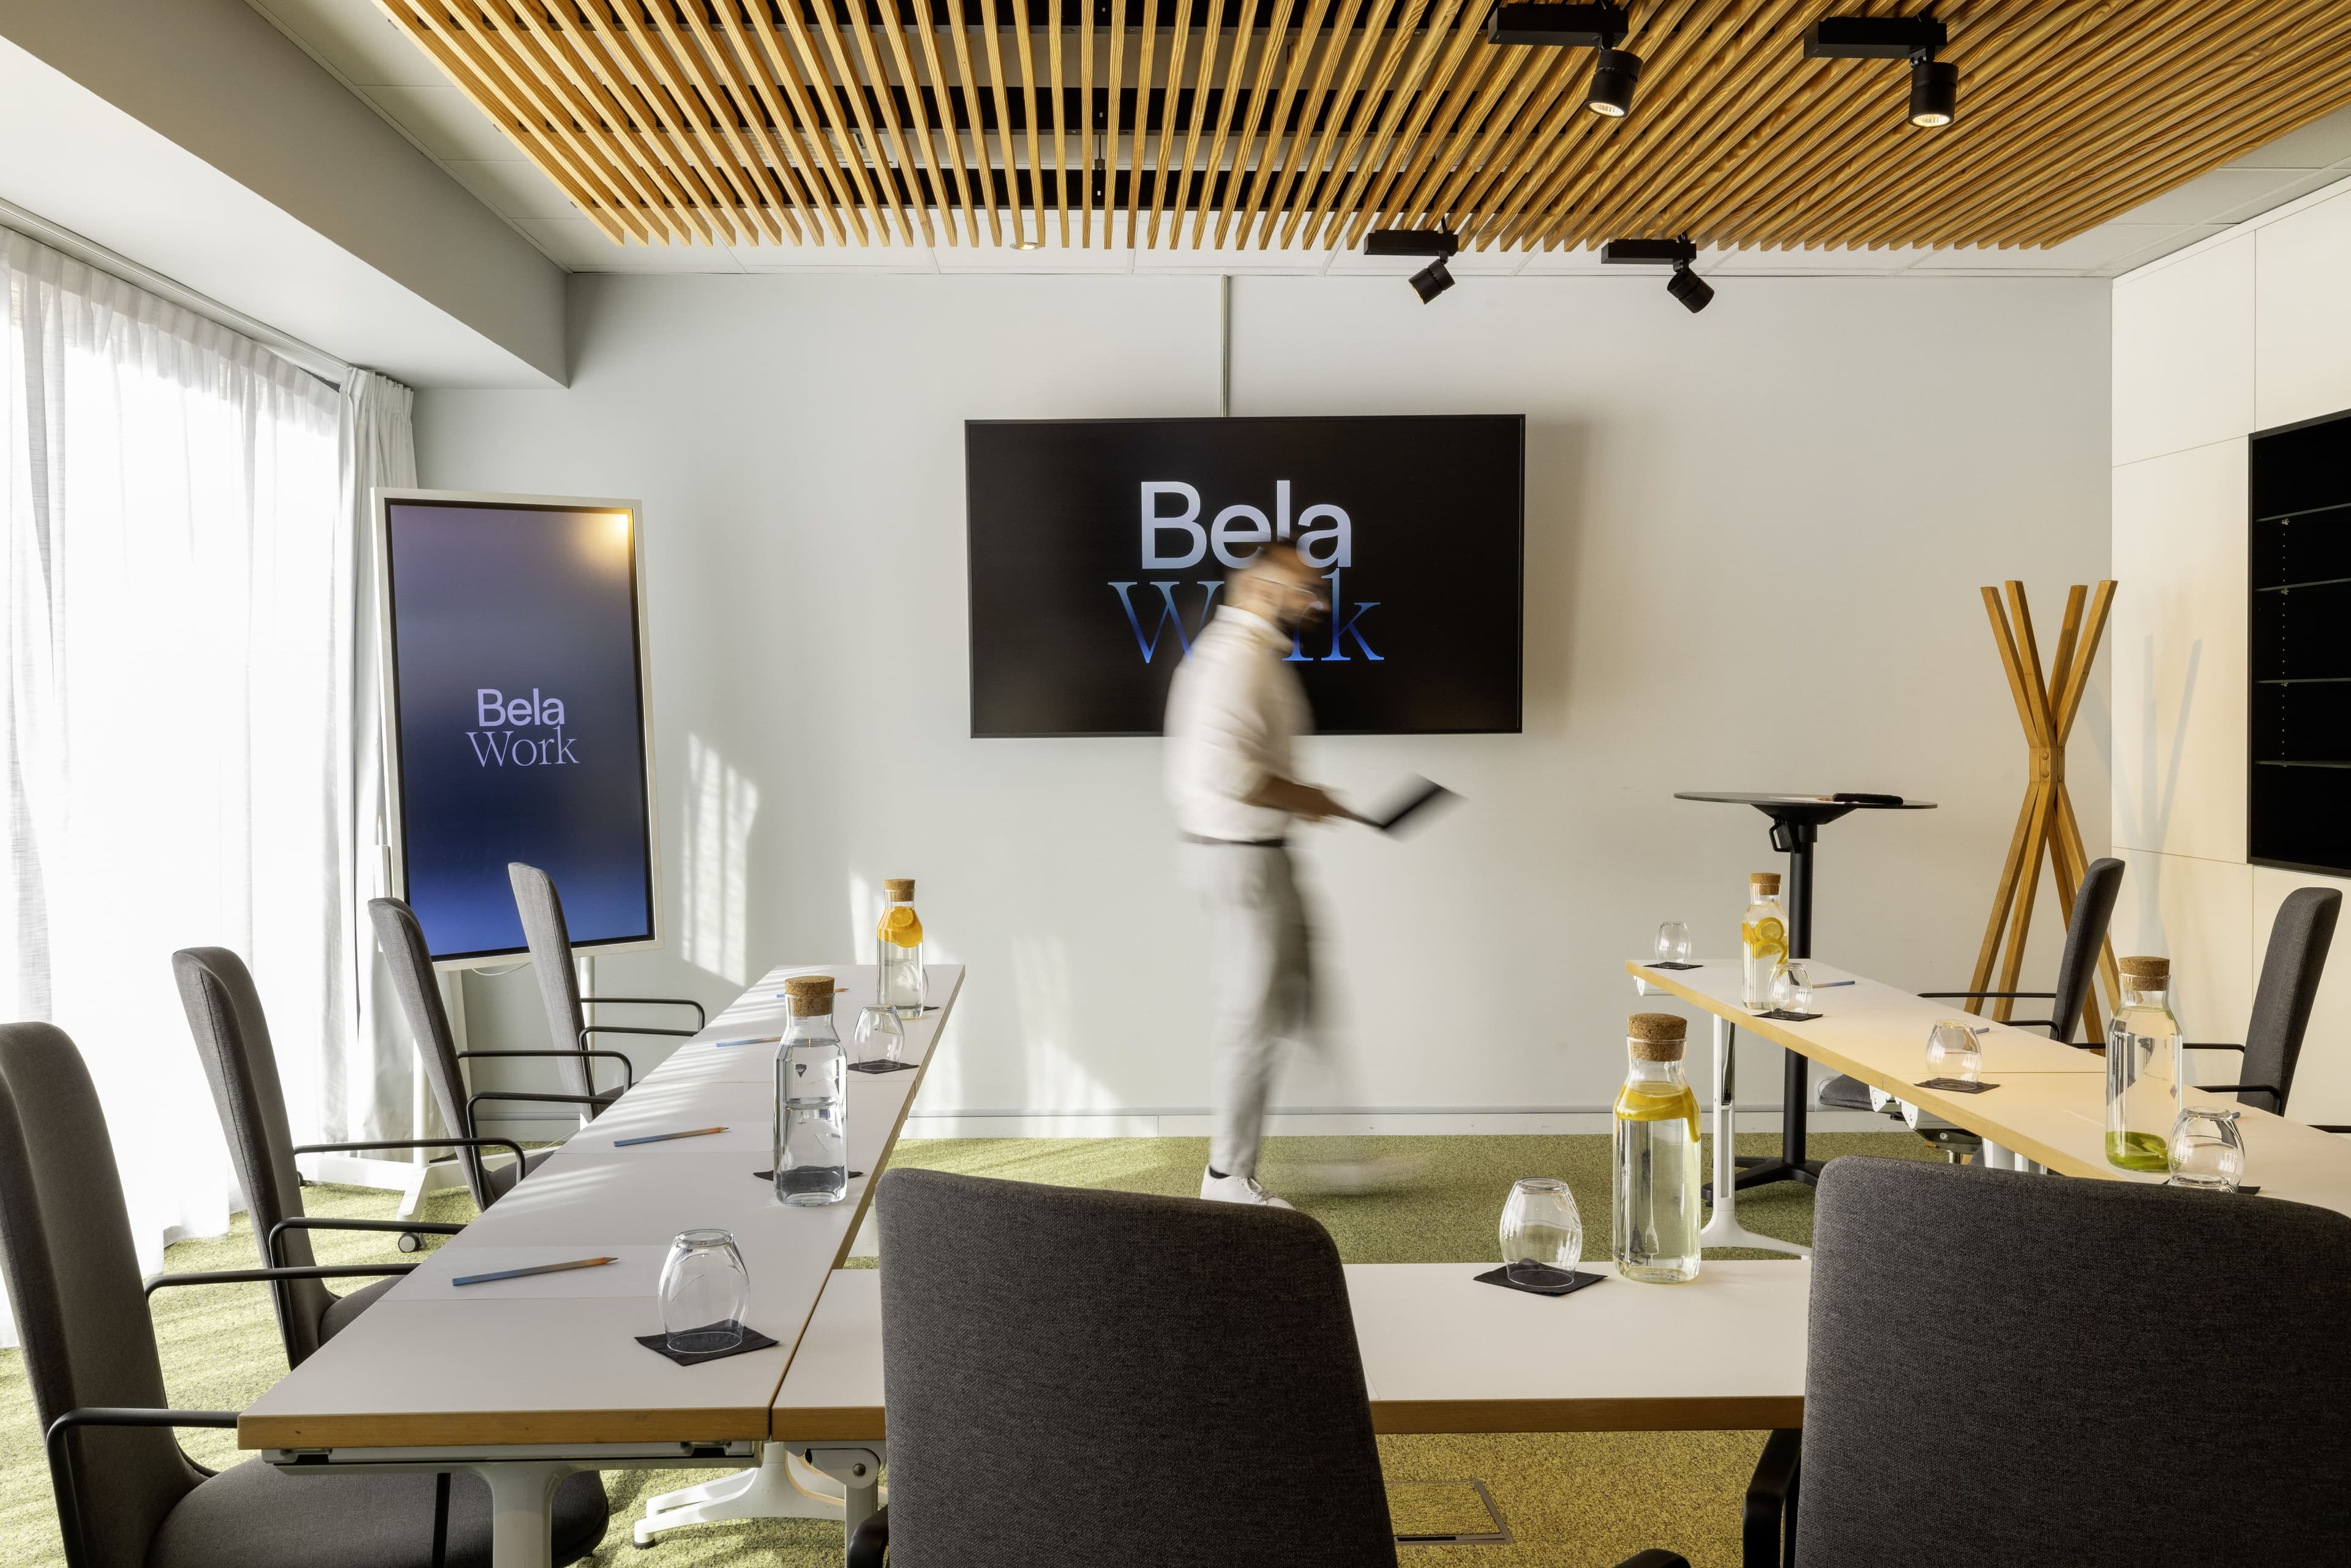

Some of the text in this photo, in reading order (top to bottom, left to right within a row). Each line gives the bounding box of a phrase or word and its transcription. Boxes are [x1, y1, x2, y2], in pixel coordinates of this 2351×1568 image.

[1141, 480, 1352, 569] Bela
[1108, 568, 1385, 664] Wrk
[477, 688, 565, 727] Bela
[465, 724, 580, 768] Work
